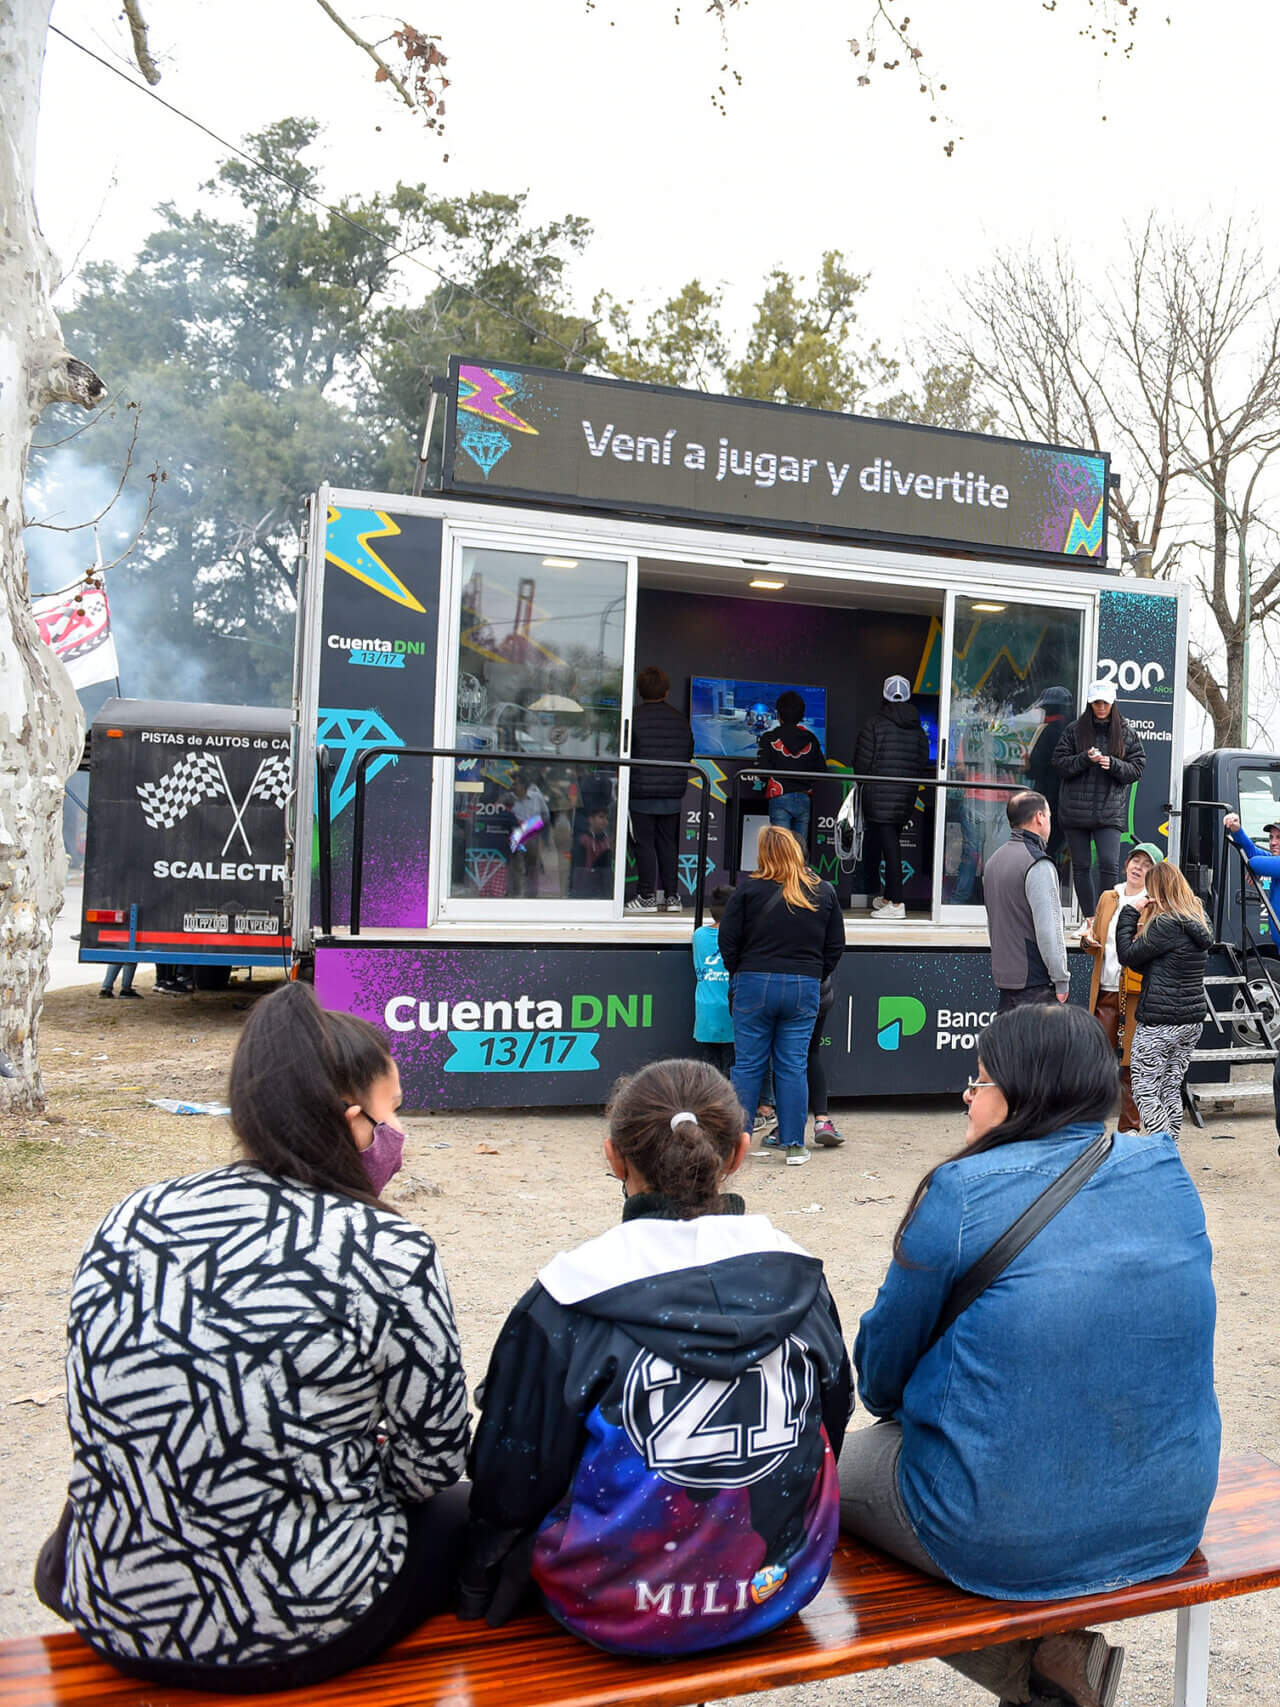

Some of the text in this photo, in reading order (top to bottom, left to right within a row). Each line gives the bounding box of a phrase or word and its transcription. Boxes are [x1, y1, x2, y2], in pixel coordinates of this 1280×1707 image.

[582, 420, 1009, 509] Vení a jugar y divertite
[327, 634, 425, 656] Cuenta DNI
[361, 651, 398, 665] 13/17
[1097, 658, 1165, 691] 200
[141, 732, 185, 744] PISTAS
[187, 735, 203, 746] de
[205, 736, 250, 748] AUTOS
[253, 738, 268, 749] de
[817, 816, 835, 828] 20
[153, 860, 287, 881] SCALECTR
[384, 994, 653, 1031] Cuenta DNI
[479, 1031, 578, 1069] 13/17
[641, 1337, 800, 1468] 21
[635, 1579, 750, 1616] MILI
